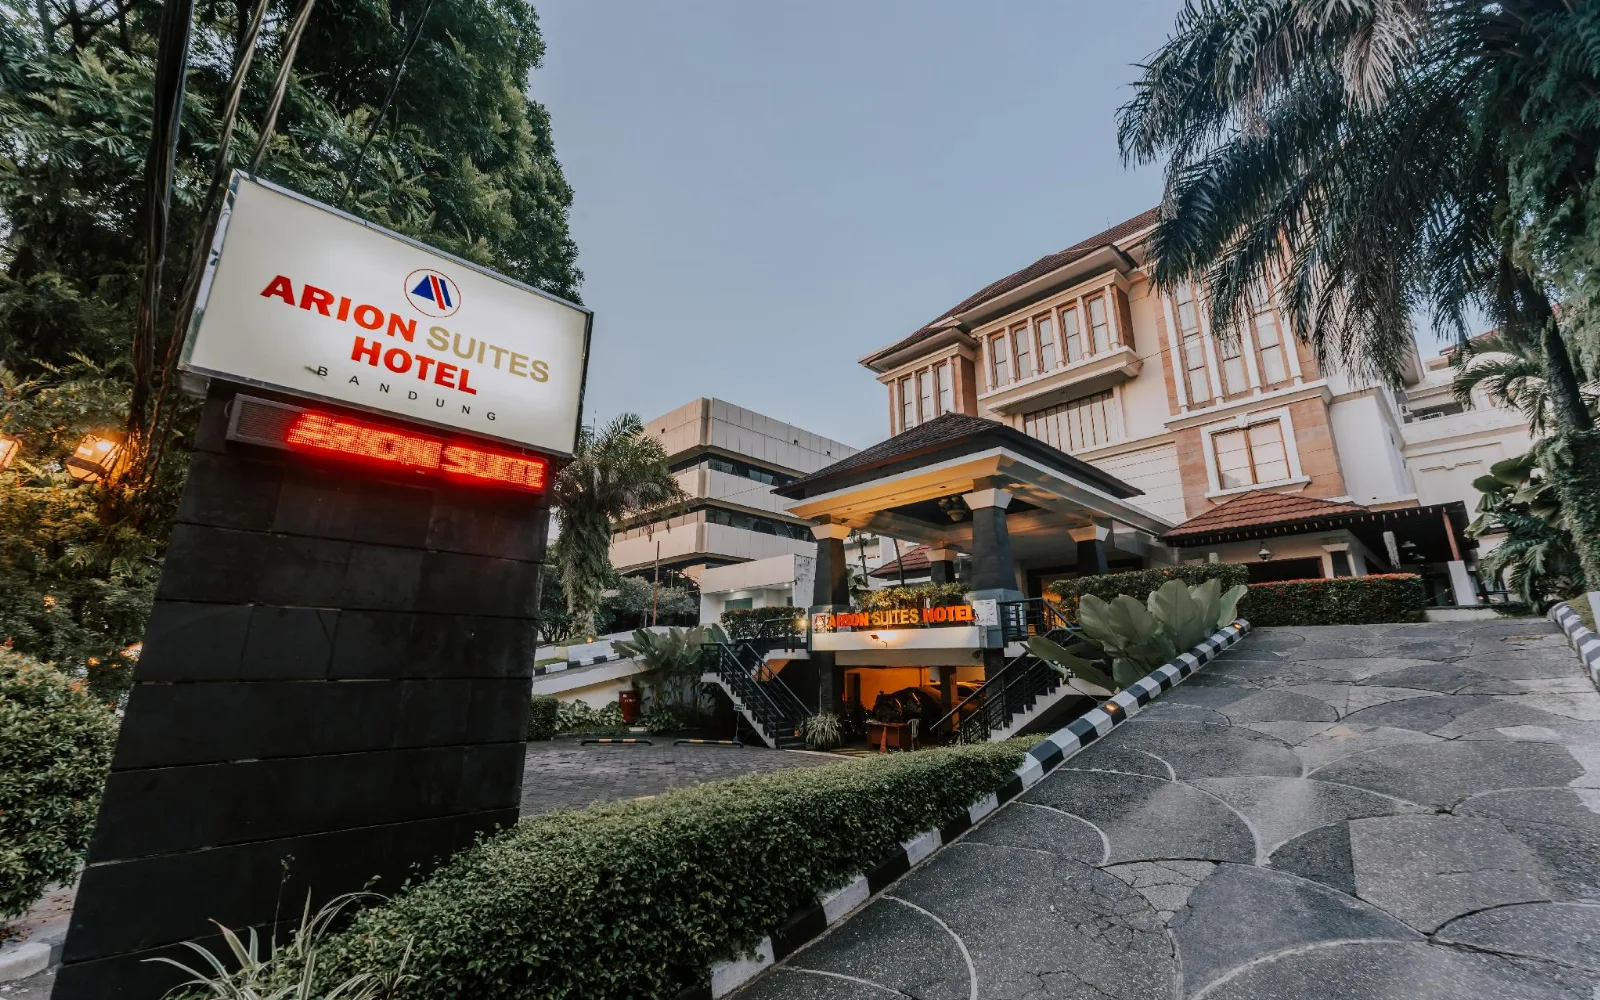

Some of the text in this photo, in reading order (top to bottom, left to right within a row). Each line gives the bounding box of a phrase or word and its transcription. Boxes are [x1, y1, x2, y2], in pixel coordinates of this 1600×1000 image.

[260, 274, 549, 383] ARION SUITES
[316, 366, 496, 421] BANDUNG
[351, 336, 477, 395] HOTEL
[827, 605, 976, 628] ARION SUITES HOTEL
